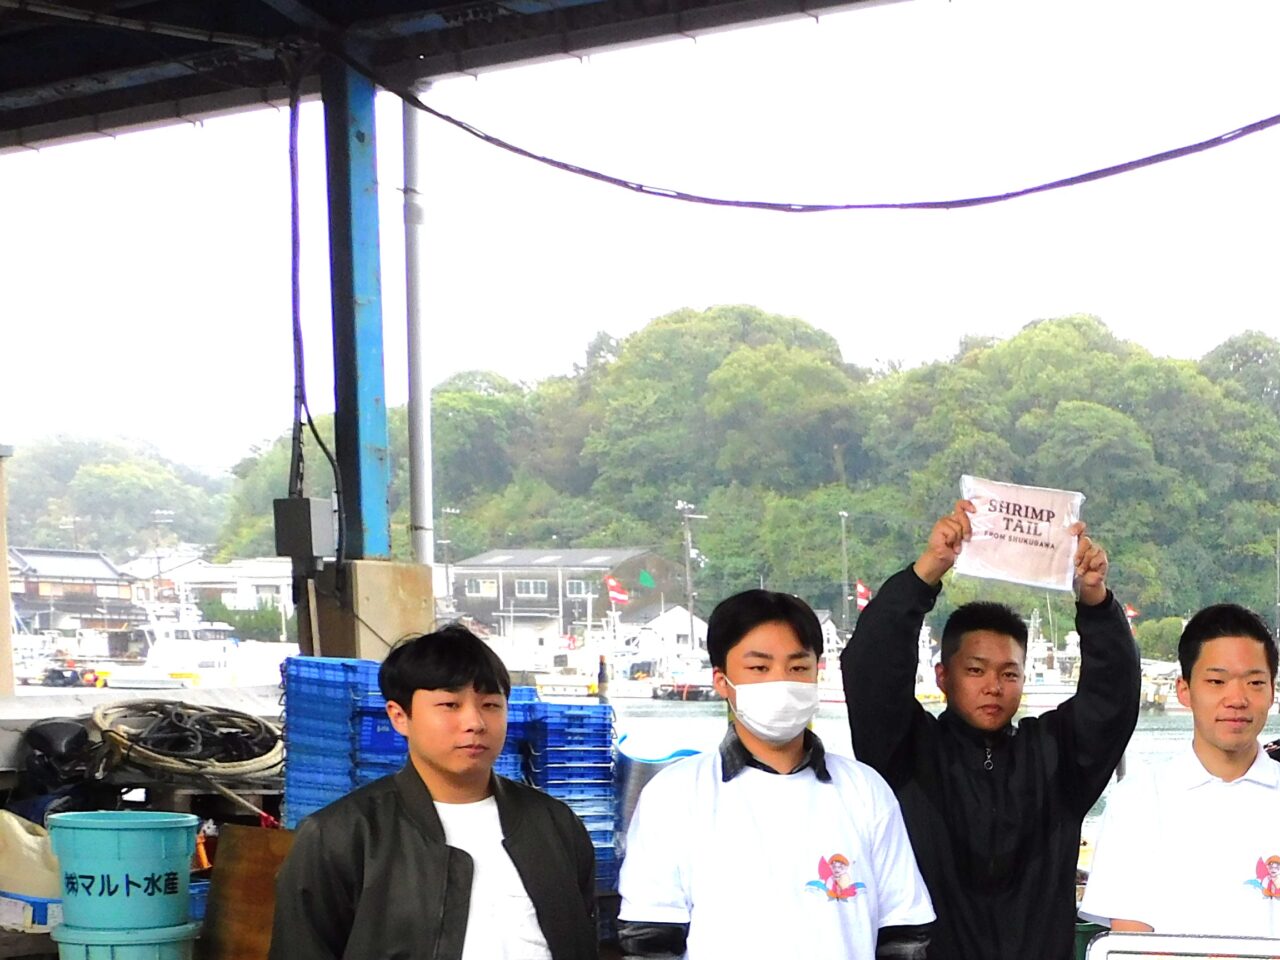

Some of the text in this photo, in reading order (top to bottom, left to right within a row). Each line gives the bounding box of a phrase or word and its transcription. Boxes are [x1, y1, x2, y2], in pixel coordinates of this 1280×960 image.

[988, 499, 1056, 523] SHRIMP
[984, 530, 1006, 540] FROM
[1003, 517, 1043, 537] TAIL
